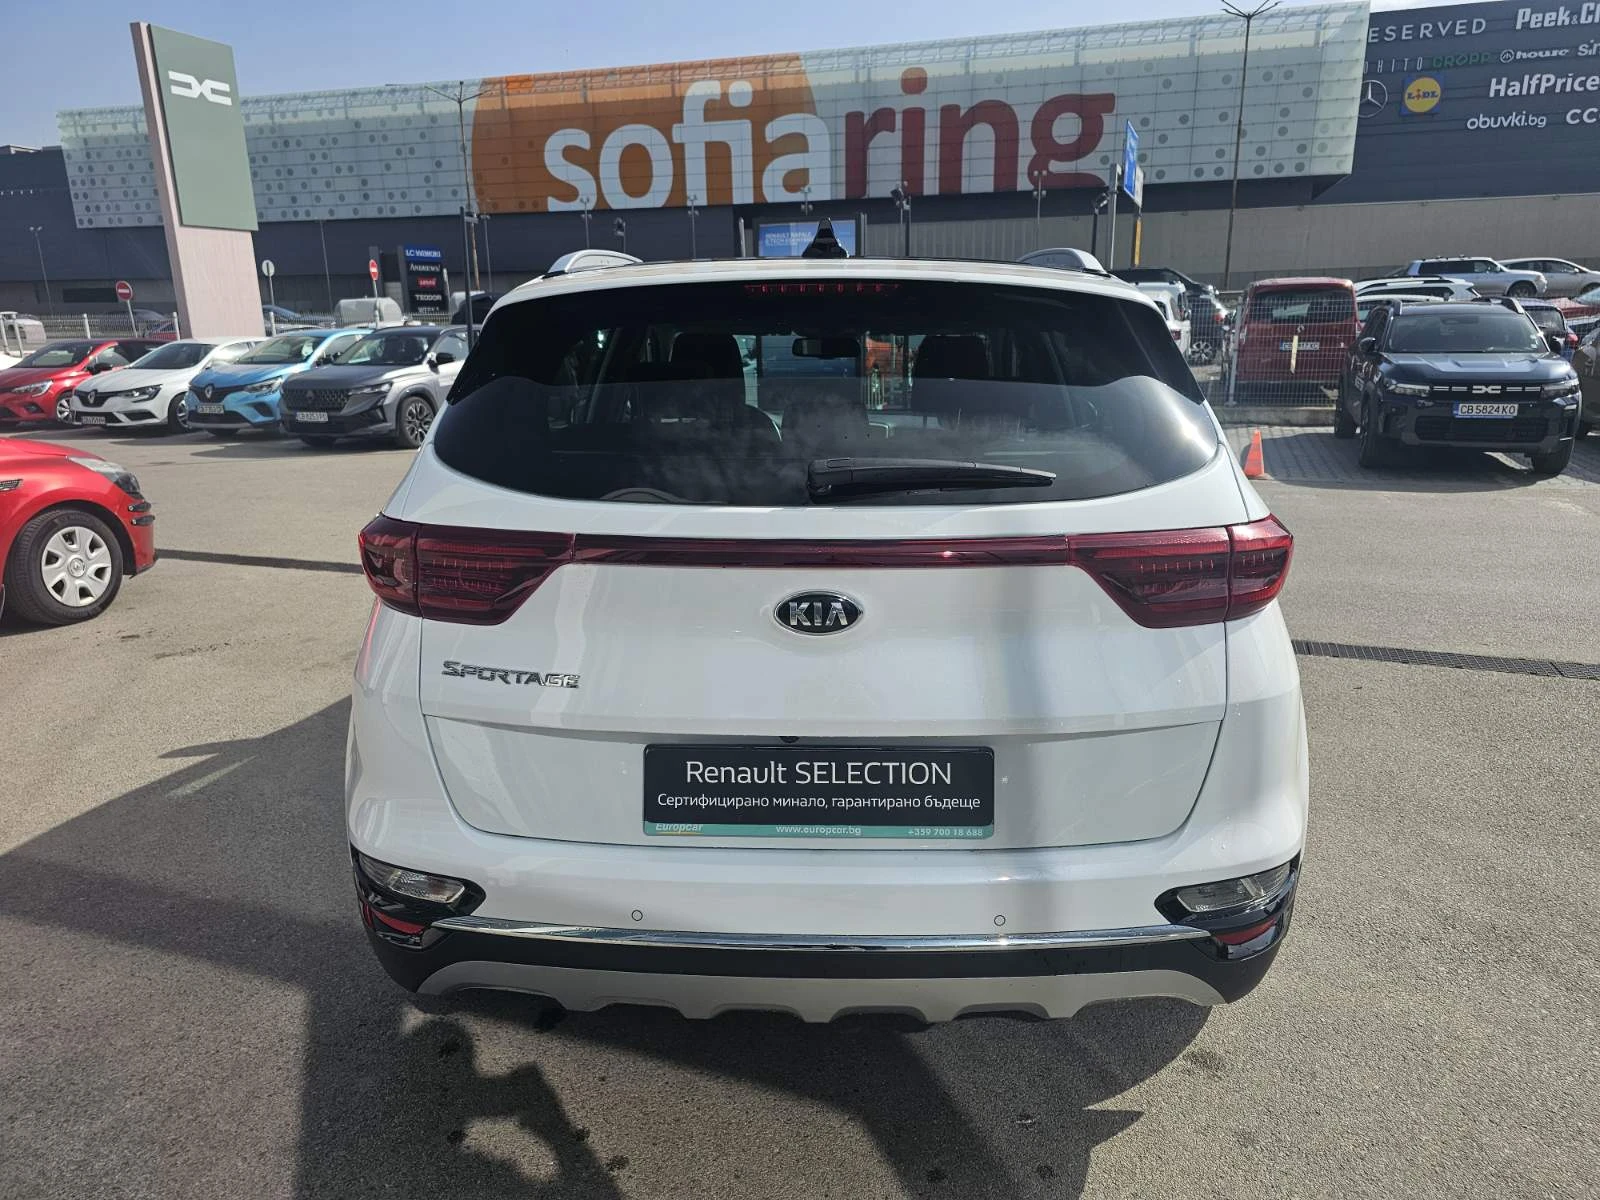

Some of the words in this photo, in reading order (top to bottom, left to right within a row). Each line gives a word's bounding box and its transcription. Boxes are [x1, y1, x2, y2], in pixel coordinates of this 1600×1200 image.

[1367, 18, 1486, 43] ESERVED
[1489, 72, 1600, 98] HalfPrice
[1466, 110, 1547, 130] obuvki.bg
[1566, 107, 1600, 125] CC
[788, 601, 849, 626] KIA
[441, 660, 581, 689] SPORTAGE
[686, 760, 788, 784] Renault
[795, 761, 952, 785] SELECTION
[657, 793, 769, 810] Сертифицирано
[773, 796, 828, 809] минало,
[832, 797, 921, 811] гарантирано
[924, 795, 981, 810] бъдеще
[776, 824, 861, 836] www.europcar.bg
